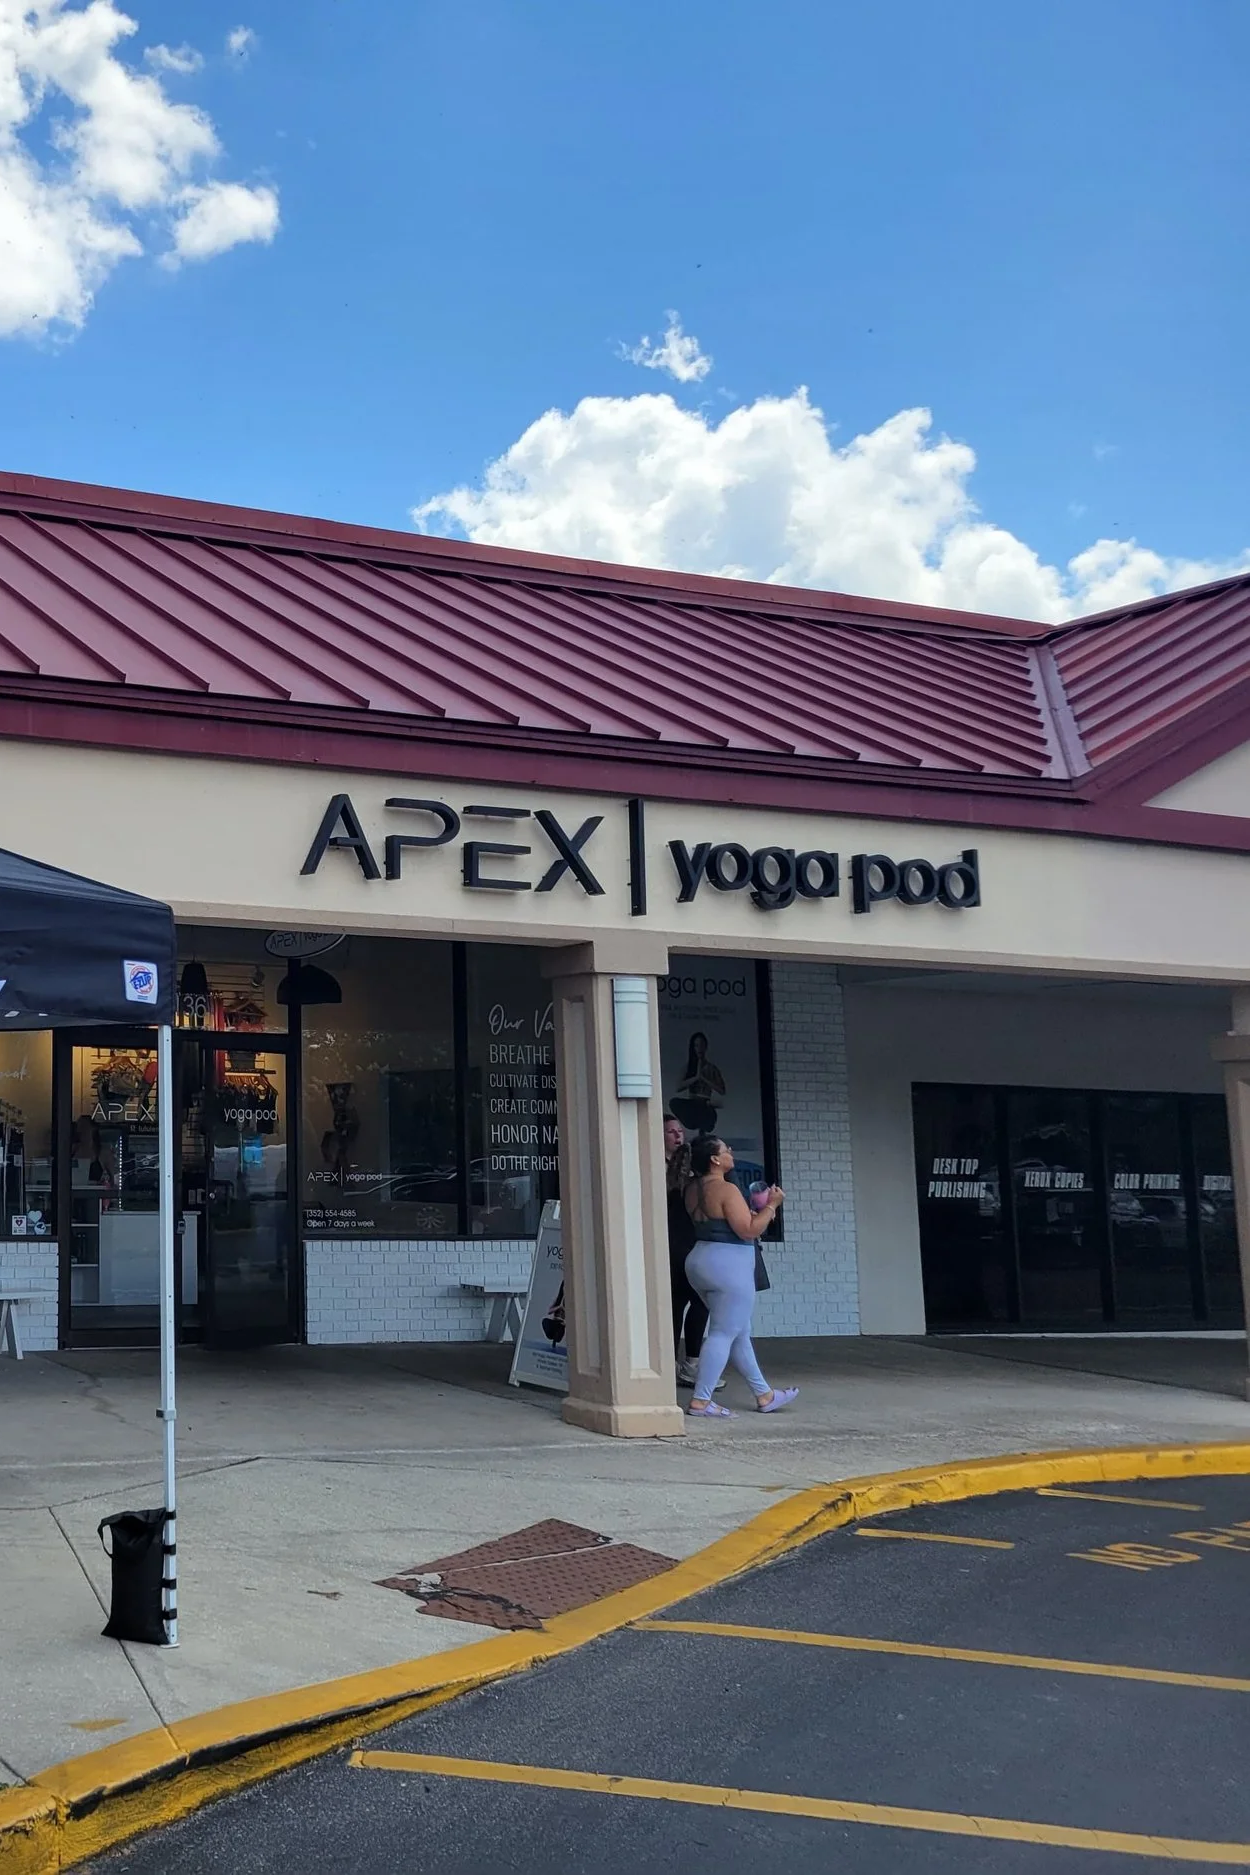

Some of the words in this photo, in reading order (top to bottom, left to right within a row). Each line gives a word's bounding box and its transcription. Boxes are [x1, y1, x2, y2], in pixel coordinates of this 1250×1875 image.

[300, 793, 605, 896] APEX
[667, 839, 840, 910] yoga
[852, 848, 981, 914] pod
[657, 976, 696, 999] oga
[703, 976, 746, 999] pod
[488, 1003, 525, 1036] Our
[534, 1002, 556, 1039] Va
[489, 1043, 551, 1065] BREATHE
[489, 1073, 539, 1089] CULTIVATE
[541, 1075, 557, 1089] DIS
[91, 1102, 155, 1121] APEX
[224, 1107, 252, 1123] yoga
[255, 1107, 278, 1121] pod
[490, 1098, 528, 1114] CREATE
[491, 1124, 539, 1145] HONOR
[542, 1125, 559, 1145] NA
[491, 1155, 507, 1171] DO
[510, 1155, 530, 1171] THE
[932, 1157, 959, 1175] DESK
[960, 1158, 979, 1175] TOP
[306, 1171, 339, 1182] APEX
[345, 1173, 365, 1182] yoga
[366, 1172, 383, 1181] pod
[1024, 1171, 1050, 1188] XEROX
[1054, 1172, 1085, 1188] COPIES
[928, 1181, 987, 1198] PUBLISHING
[306, 1219, 327, 1228] Open
[333, 1219, 350, 1228] days
[357, 1219, 376, 1227] week
[546, 1244, 564, 1260] yog
[1065, 1542, 1202, 1572] NO
